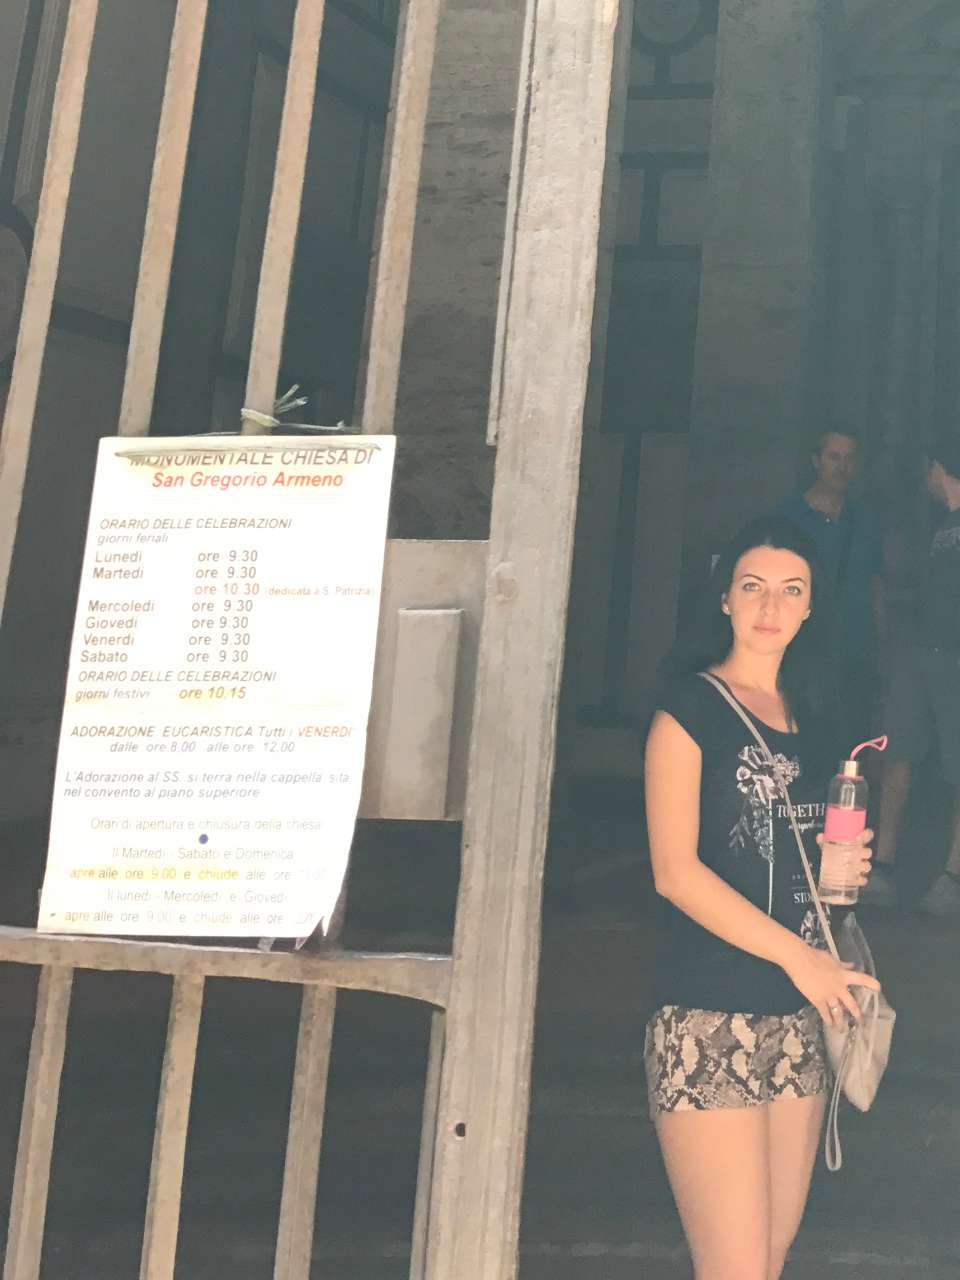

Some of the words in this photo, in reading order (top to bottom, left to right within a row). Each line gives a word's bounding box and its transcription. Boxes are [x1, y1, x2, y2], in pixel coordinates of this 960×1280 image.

[281, 449, 350, 466] CHIESA
[354, 449, 373, 465] DI
[152, 472, 184, 488] San
[190, 472, 267, 491] Gregorio
[272, 471, 344, 488] Armeno
[99, 518, 150, 529] ORARIO
[152, 518, 192, 529] DELLE
[196, 518, 292, 529] CELEBRAZIONI
[97, 533, 132, 546] giorni
[136, 533, 168, 543] feriali
[198, 552, 219, 562] ore
[228, 550, 258, 562] 9.30
[195, 568, 218, 579] ore
[227, 566, 256, 579] 9.30
[194, 585, 217, 596] ore
[223, 583, 260, 596] 10.30
[192, 601, 214, 612] ore
[223, 599, 253, 612] 9.30
[191, 618, 214, 629] ore
[219, 616, 249, 629] 9.30
[188, 635, 212, 646] ore
[220, 633, 250, 646] 9.30
[80, 650, 128, 663] Sabato
[186, 652, 209, 663] ore
[218, 650, 249, 663] 9.30
[78, 670, 127, 682] ORARIO
[130, 670, 174, 682] DELLE
[177, 670, 276, 682] CELEBRAZIONI
[75, 688, 109, 702] giorni
[179, 689, 202, 700] ore
[208, 686, 247, 700] 10.15
[70, 725, 155, 737] ADORAZIONE
[162, 725, 253, 737] EUCARISTICA
[259, 725, 286, 737] Tutti
[110, 740, 139, 753] dalle
[146, 743, 167, 753] ore
[206, 740, 229, 753] alle
[234, 743, 254, 753] ore
[65, 770, 144, 783] L'Adorazione
[147, 770, 160, 783] al
[236, 770, 266, 783] nella
[63, 786, 81, 798] nel
[84, 787, 141, 798] convento
[144, 786, 156, 798] al
[158, 787, 194, 800] piano
[98, 867, 118, 880] alle
[125, 869, 144, 880] ore
